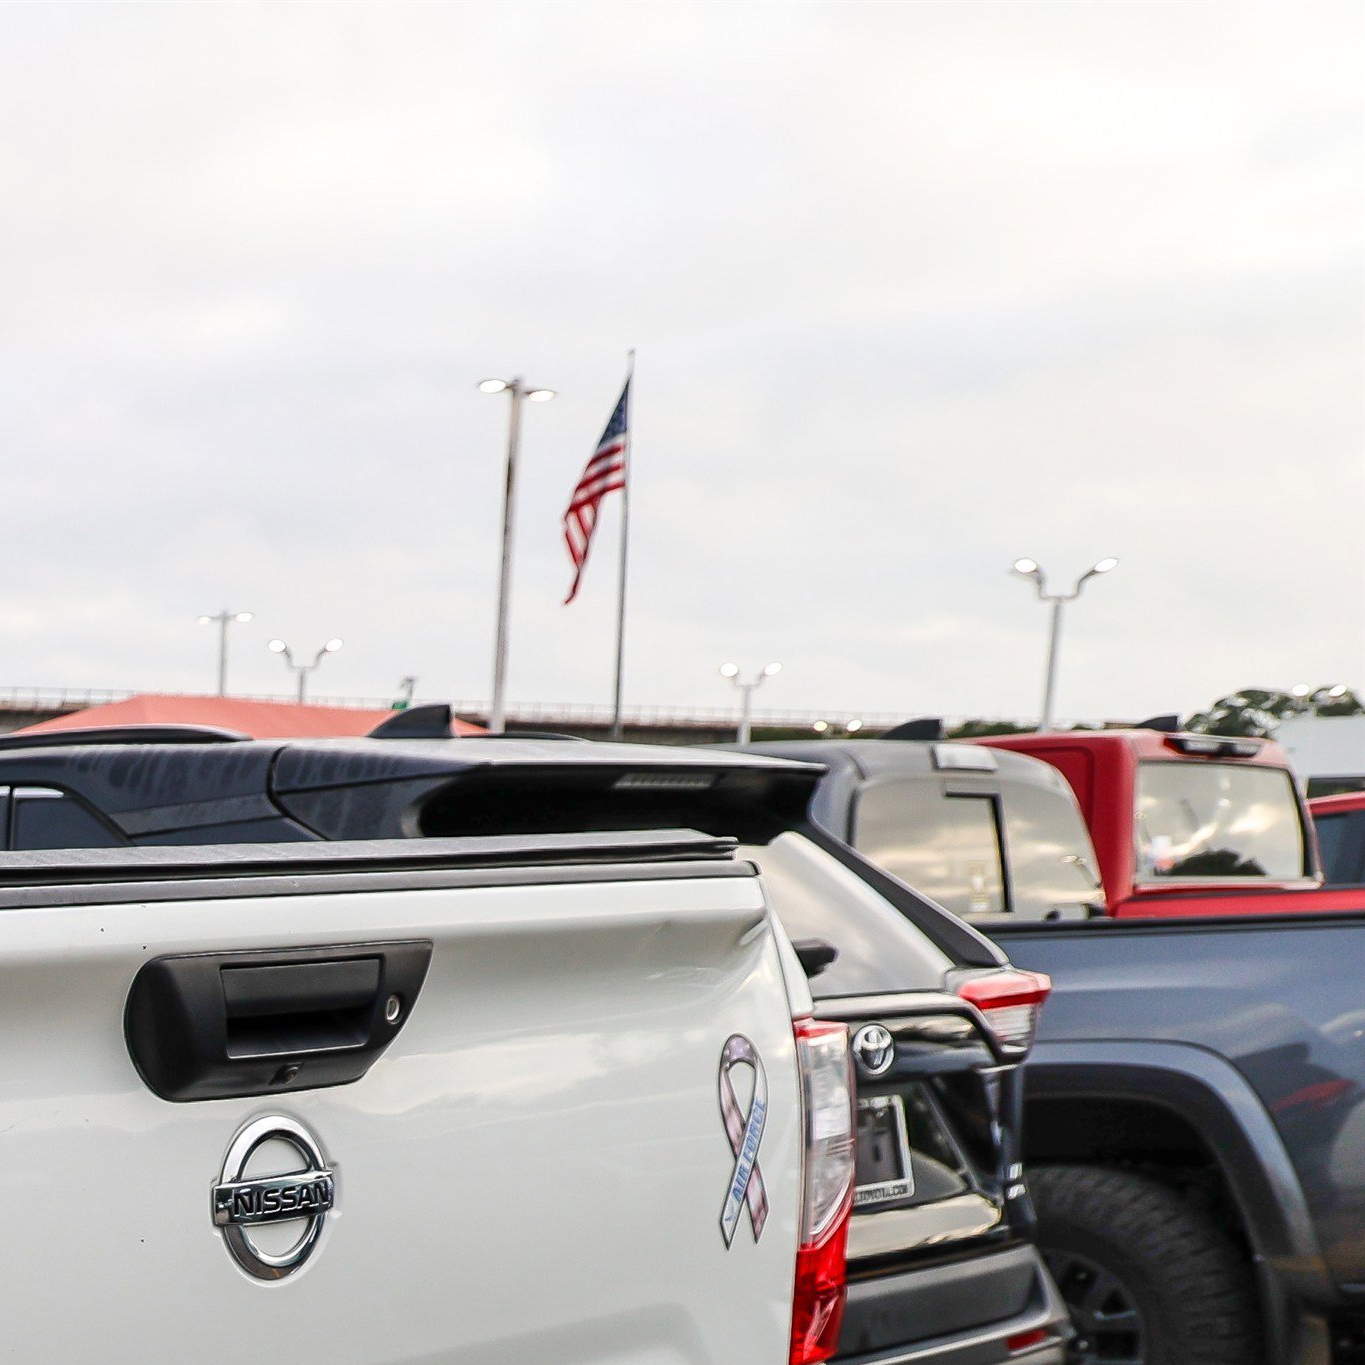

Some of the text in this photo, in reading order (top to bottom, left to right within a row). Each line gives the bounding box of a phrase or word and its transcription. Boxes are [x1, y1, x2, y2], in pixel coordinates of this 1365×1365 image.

[731, 1097, 766, 1203] AIR FORCE
[233, 1181, 329, 1217] NISSAN
